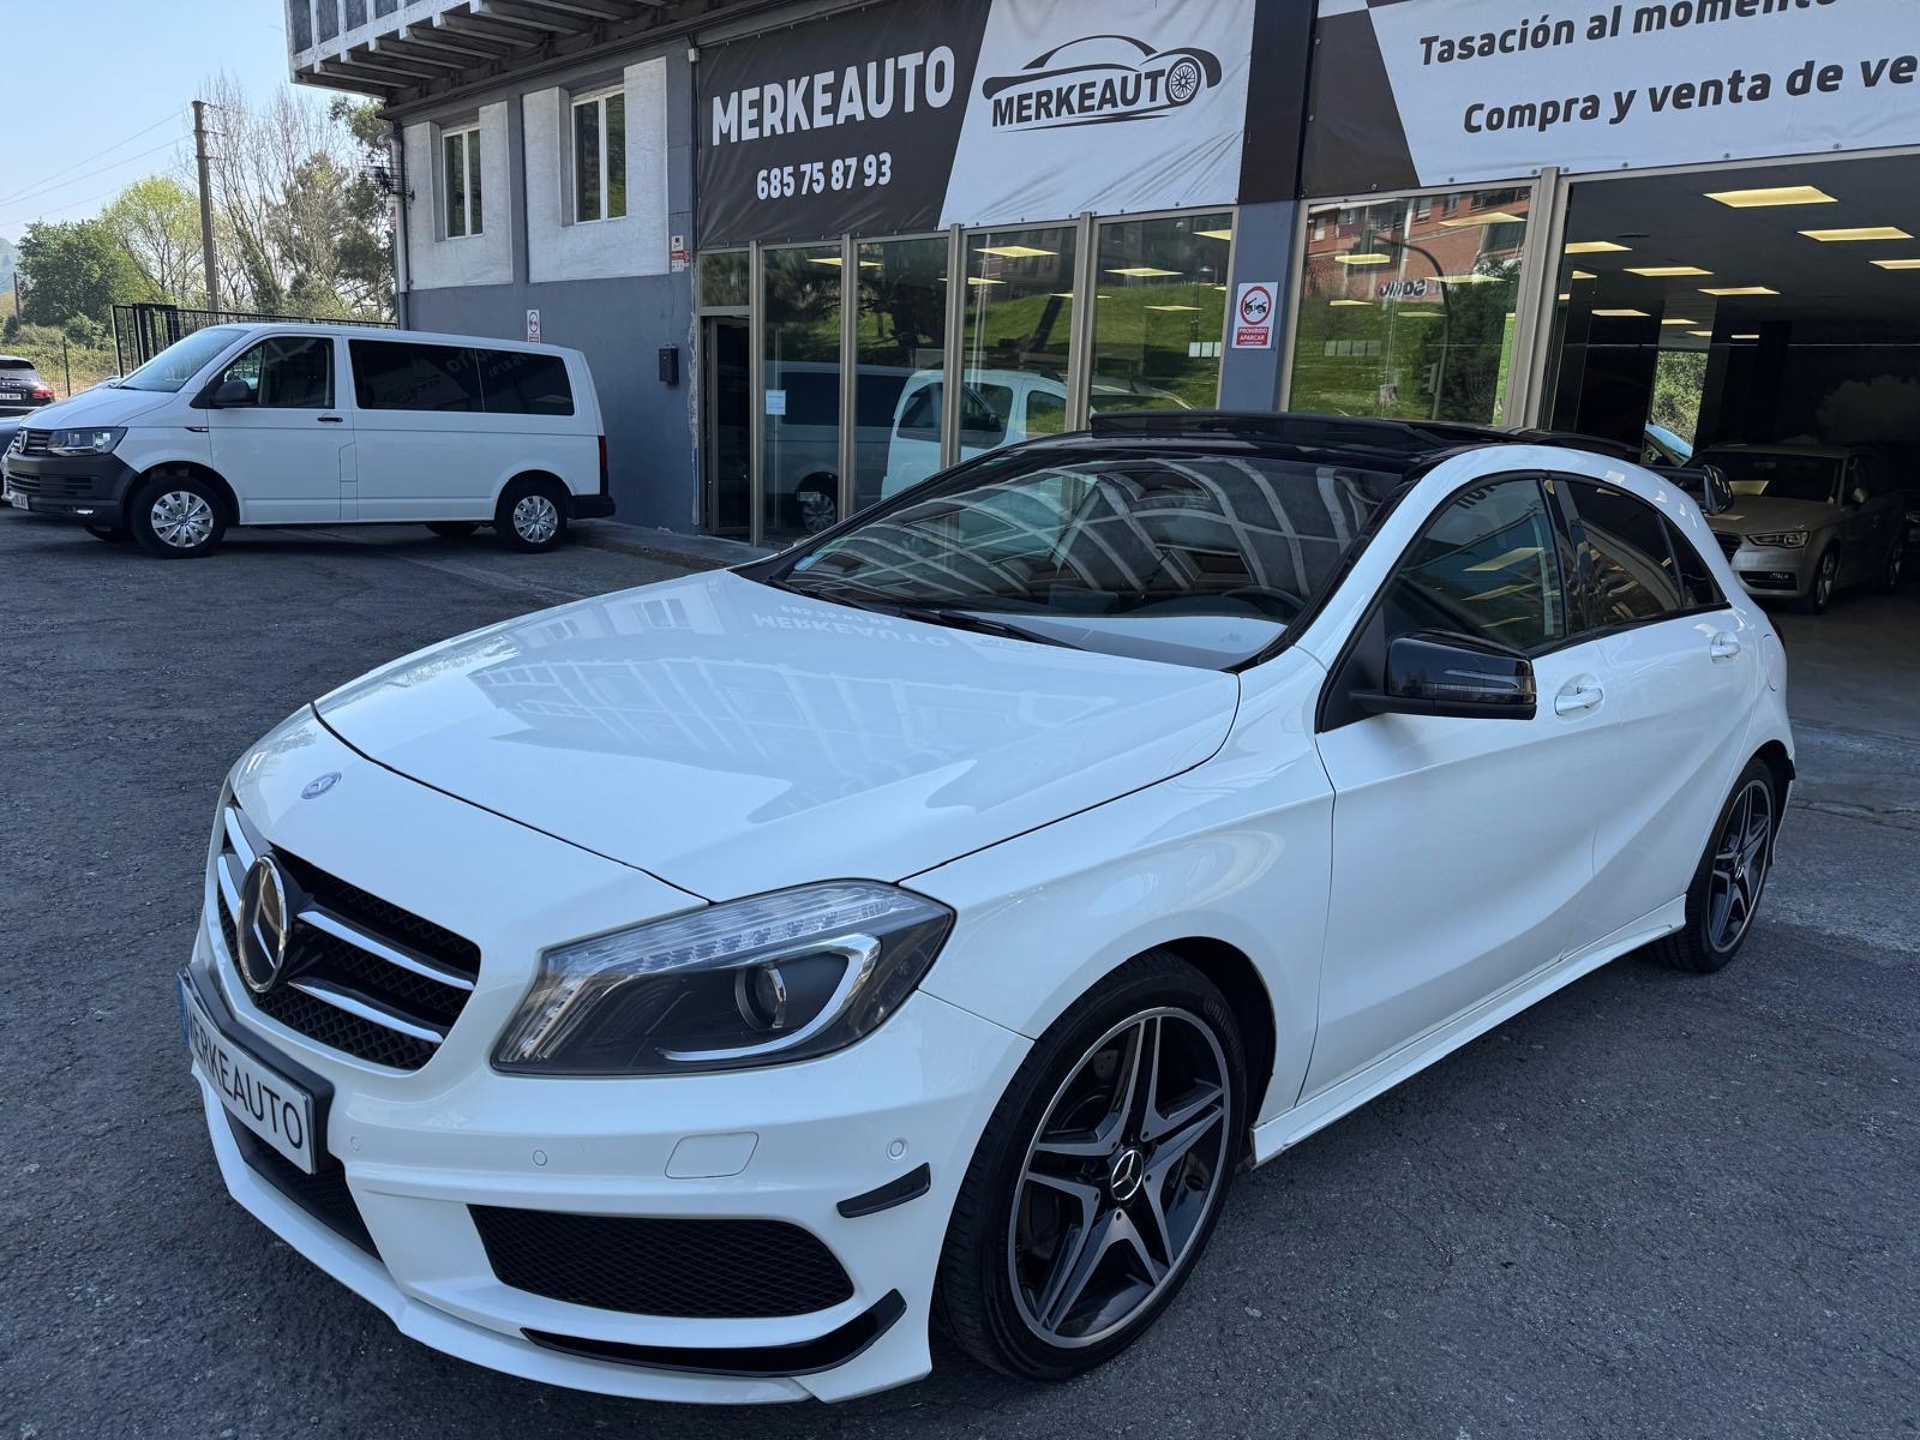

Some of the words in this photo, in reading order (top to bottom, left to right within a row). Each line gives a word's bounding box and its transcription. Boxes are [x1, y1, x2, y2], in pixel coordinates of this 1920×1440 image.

[1420, 14, 1575, 66] Tasación
[1587, 5, 1622, 41] al
[1632, 0, 1837, 33] momen
[712, 45, 955, 146] MERKEAUTO
[1463, 94, 1601, 134] Compra
[1608, 89, 1638, 125] y
[1648, 69, 1772, 113] venta
[1786, 60, 1844, 97] de
[756, 162, 795, 200] 685
[799, 161, 825, 195] 75
[830, 156, 858, 191] 87
[863, 151, 892, 187] 93
